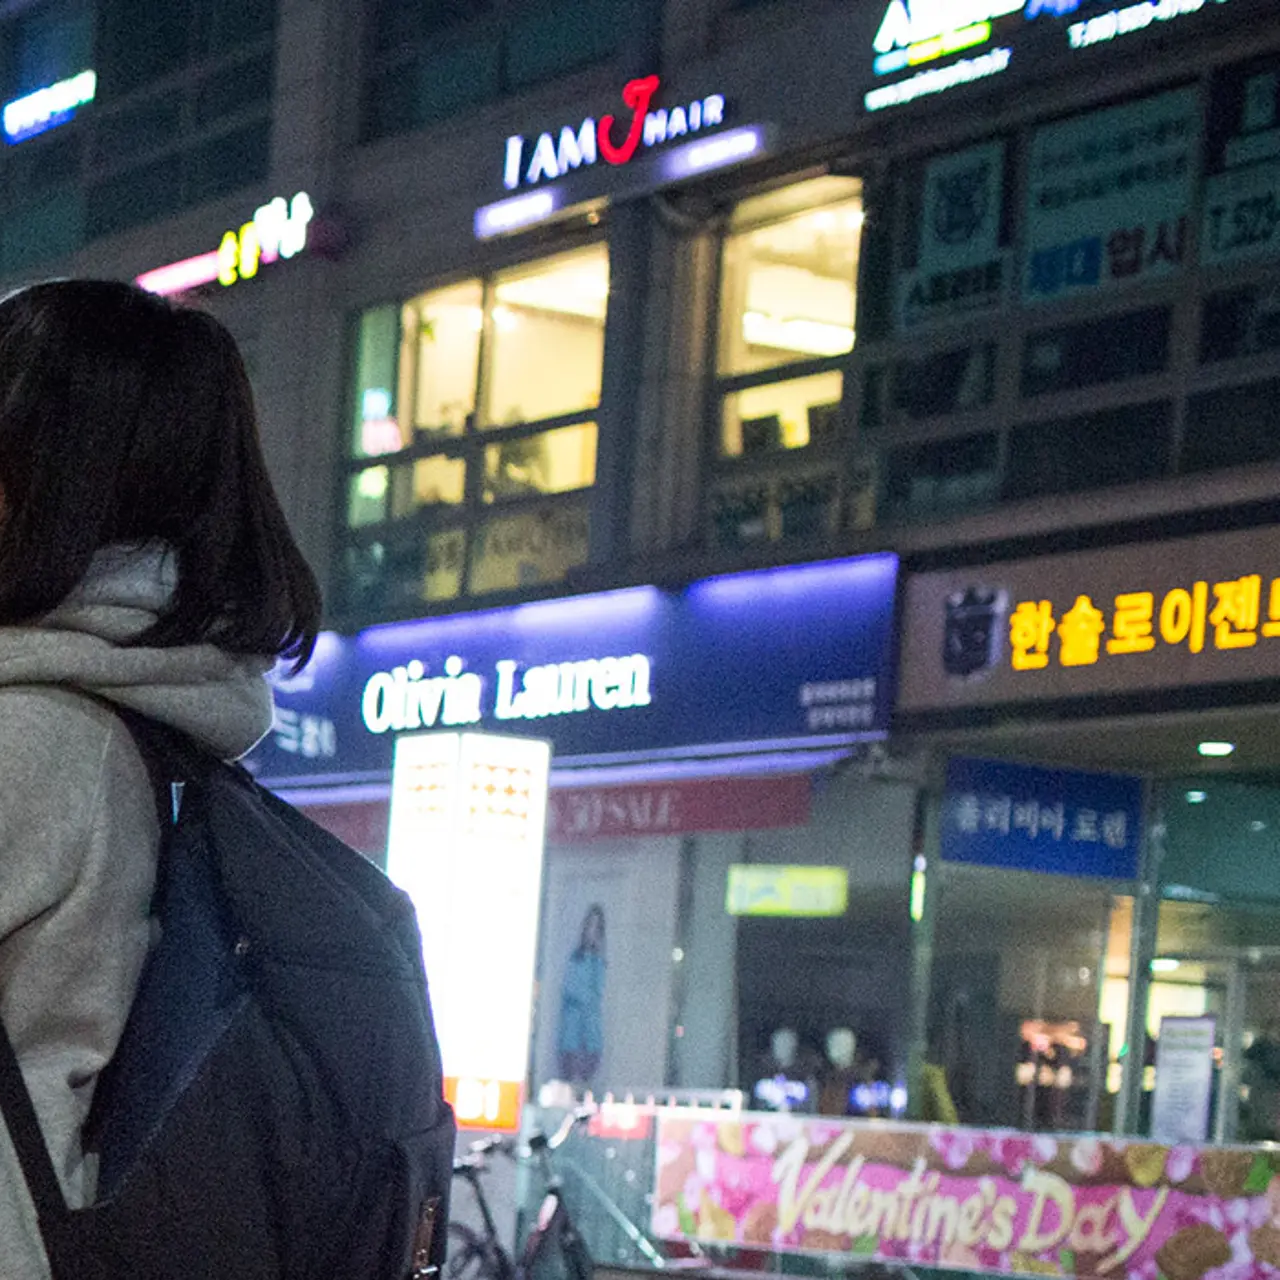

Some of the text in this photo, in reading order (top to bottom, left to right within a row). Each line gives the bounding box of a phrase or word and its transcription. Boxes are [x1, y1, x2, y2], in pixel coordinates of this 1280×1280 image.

[526, 116, 597, 184] AM
[597, 74, 660, 165] J
[643, 93, 725, 147] HAIR
[361, 655, 483, 734] Olivia
[494, 653, 652, 720] Lauren
[771, 1128, 1170, 1276] Valentine's Day
